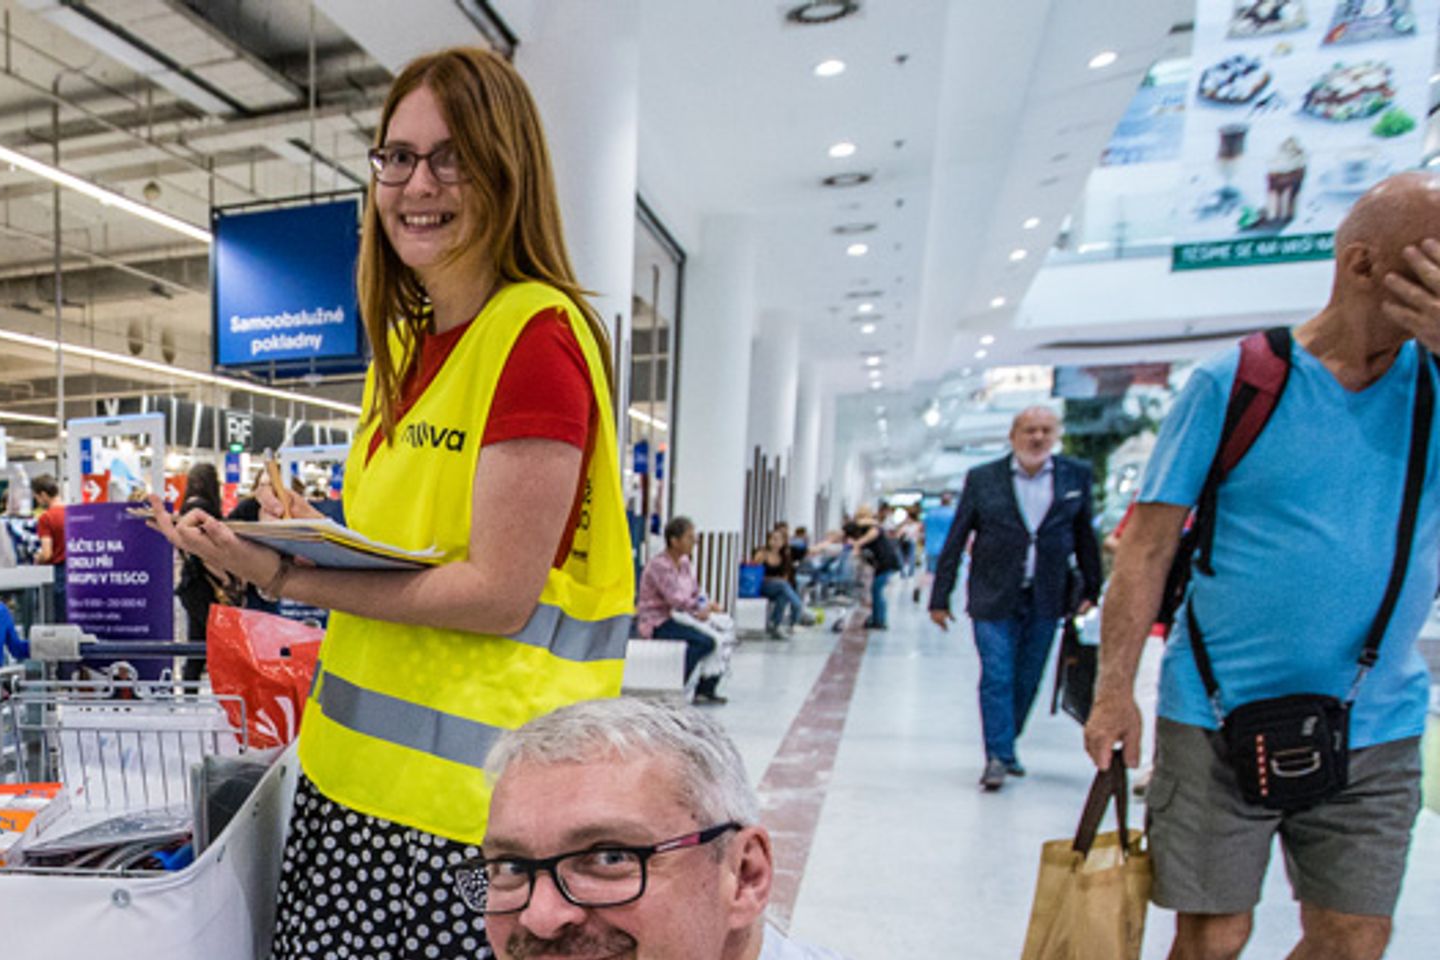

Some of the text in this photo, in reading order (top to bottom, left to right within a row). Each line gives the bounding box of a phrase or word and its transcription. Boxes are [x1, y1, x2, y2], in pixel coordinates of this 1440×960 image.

[230, 305, 345, 333] Samoobslužné
[250, 332, 323, 356] pokladny
[109, 571, 150, 585] TESCO
